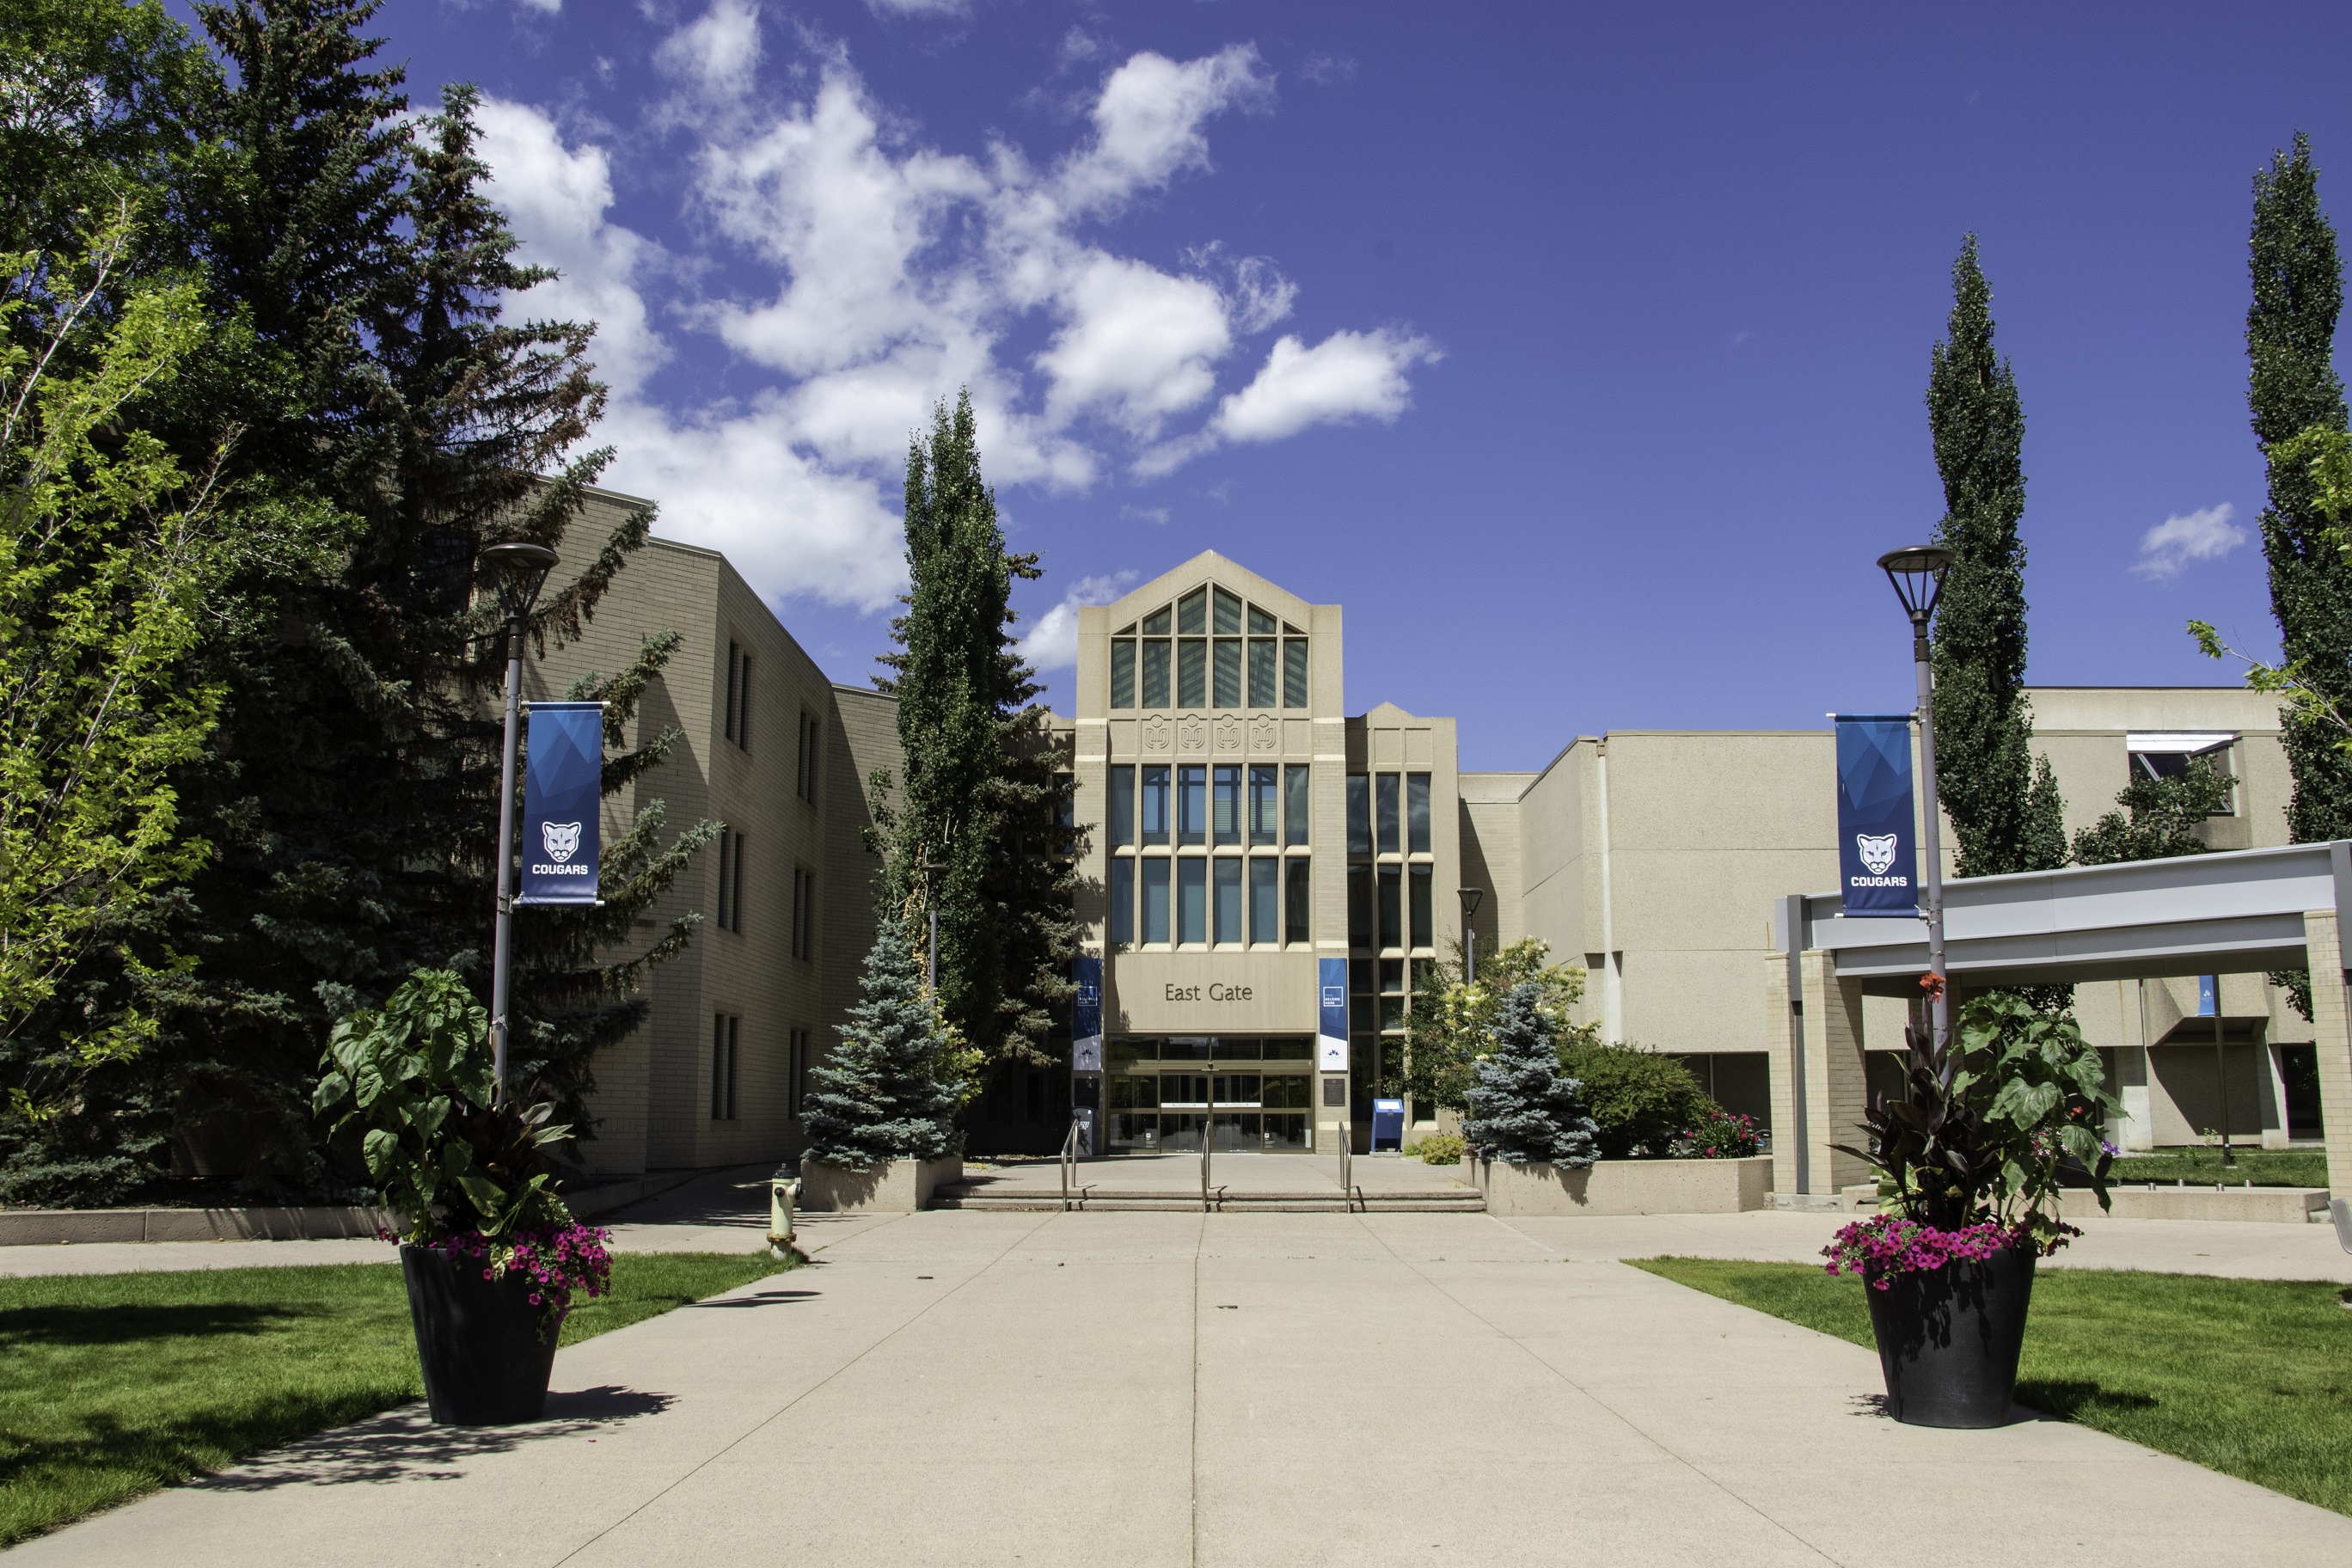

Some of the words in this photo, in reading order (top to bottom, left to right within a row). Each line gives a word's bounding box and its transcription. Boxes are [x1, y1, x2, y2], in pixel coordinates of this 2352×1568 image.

[532, 864, 588, 875] COUGARS
[1851, 876, 1908, 887] COUGARS
[1165, 983, 1201, 1001] East
[1209, 983, 1253, 1001] Gate
